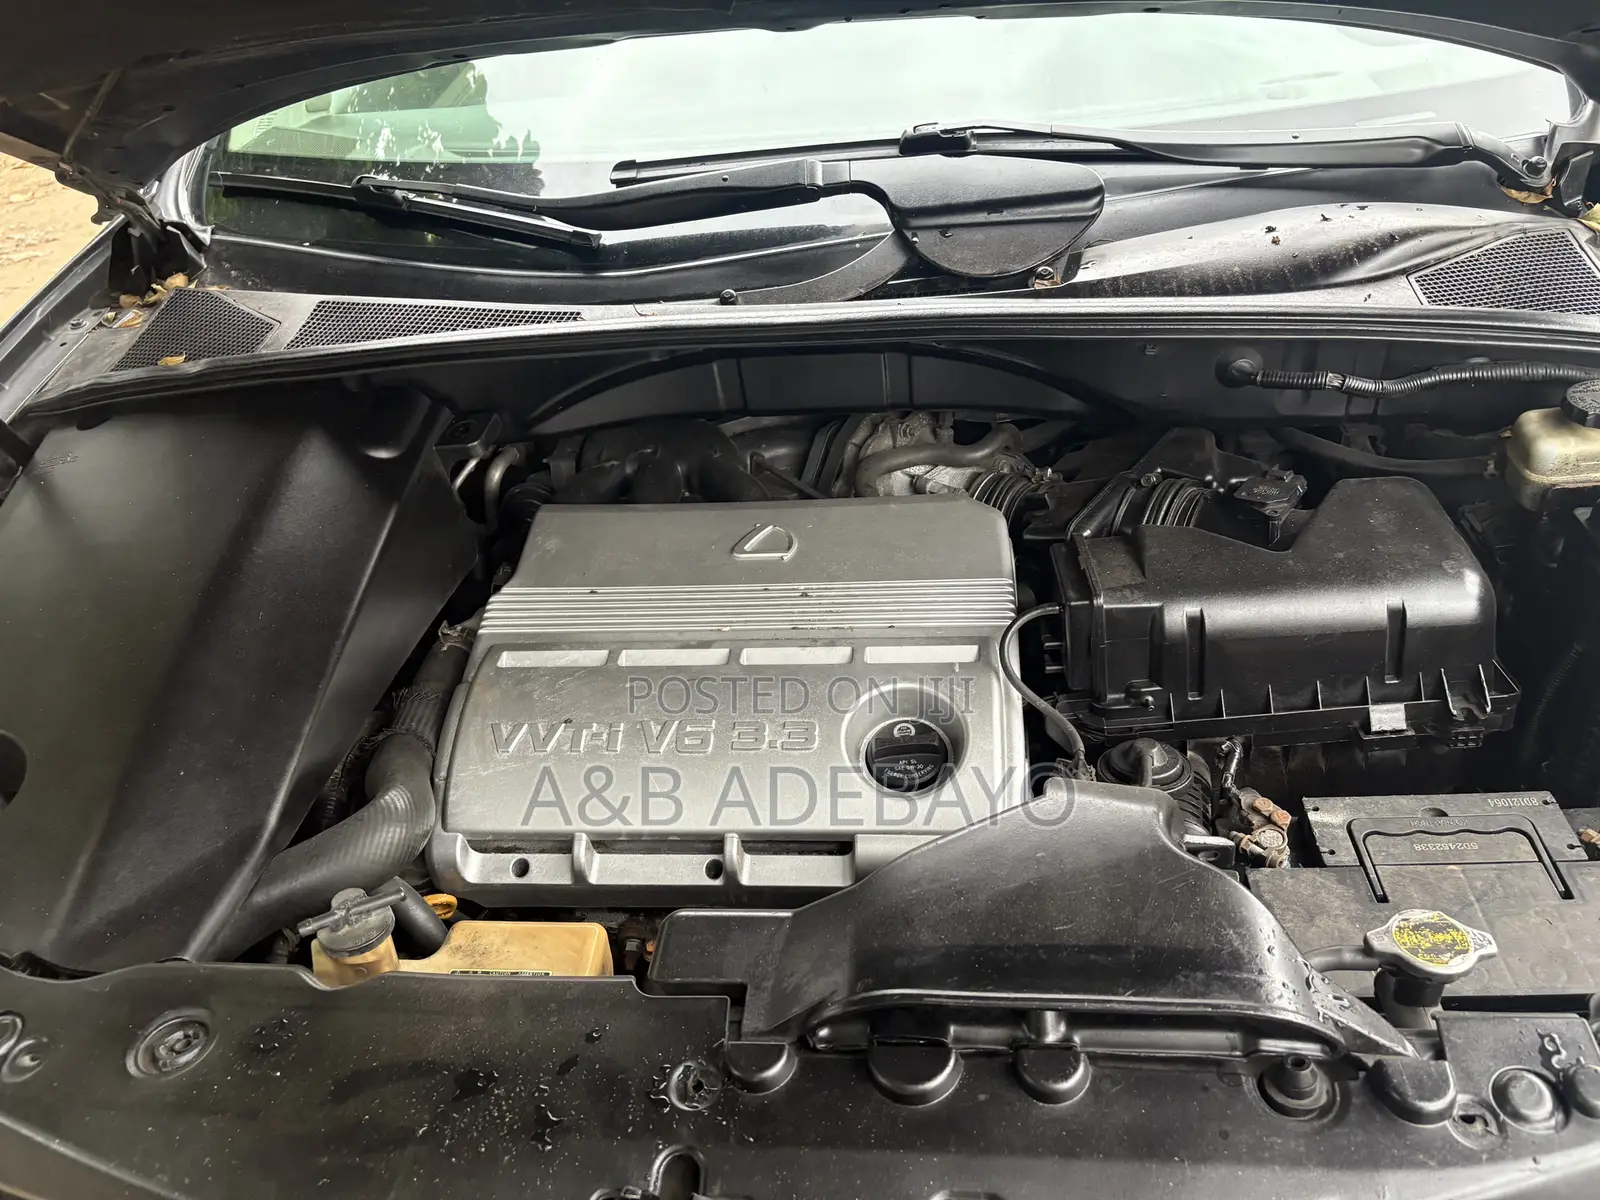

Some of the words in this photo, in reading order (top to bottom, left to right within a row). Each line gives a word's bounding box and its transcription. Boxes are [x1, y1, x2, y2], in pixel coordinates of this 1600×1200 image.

[640, 719, 716, 755] V6
[730, 720, 820, 752] 3.3
[1487, 796, 1539, 808] 8D121064
